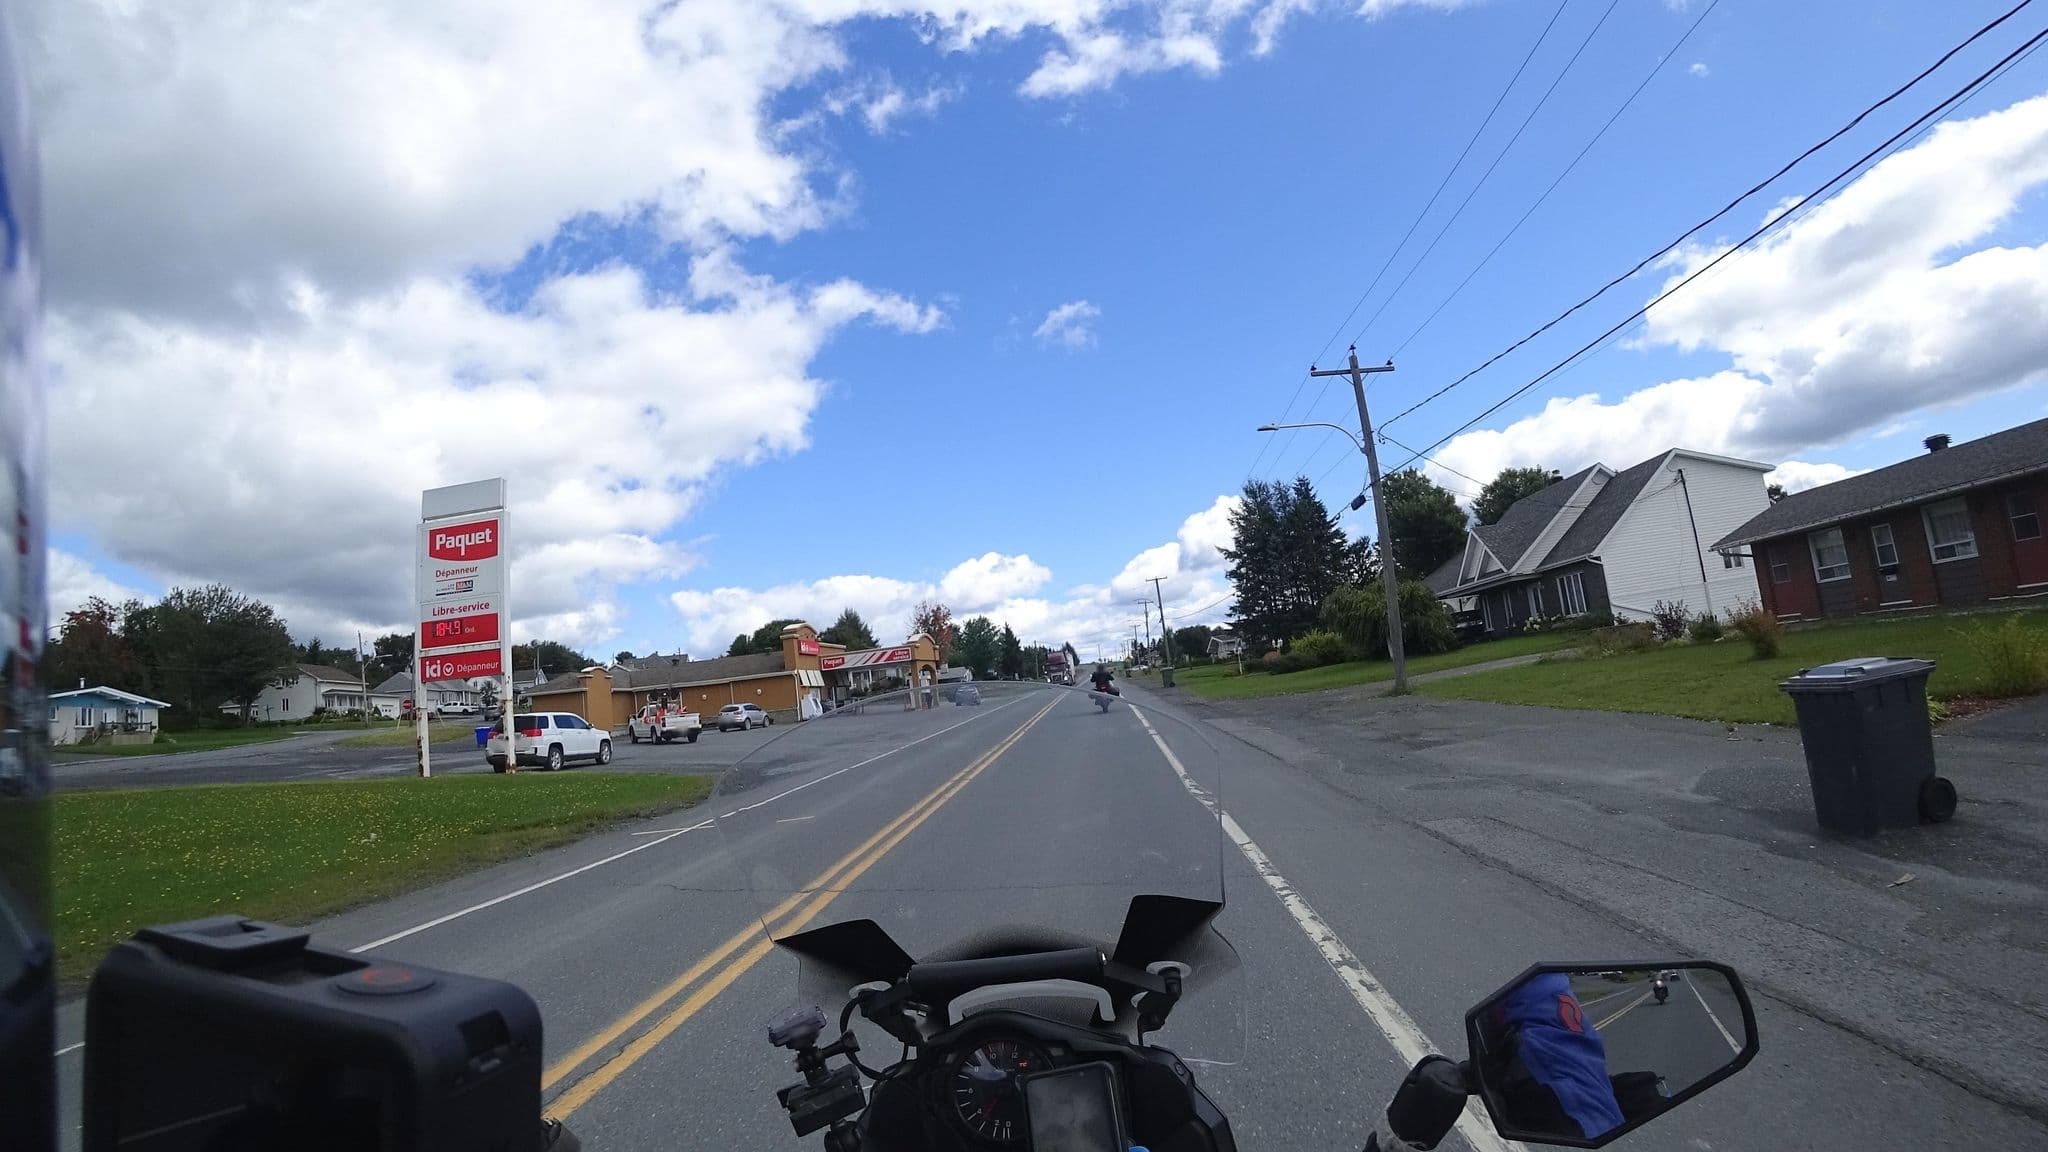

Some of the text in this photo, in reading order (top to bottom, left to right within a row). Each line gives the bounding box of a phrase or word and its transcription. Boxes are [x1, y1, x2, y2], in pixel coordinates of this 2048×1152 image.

[436, 528, 493, 556] Paquet
[435, 566, 478, 578] Dépanneur
[432, 601, 490, 616] Libre-service
[425, 660, 499, 678] ici Dépanneur
